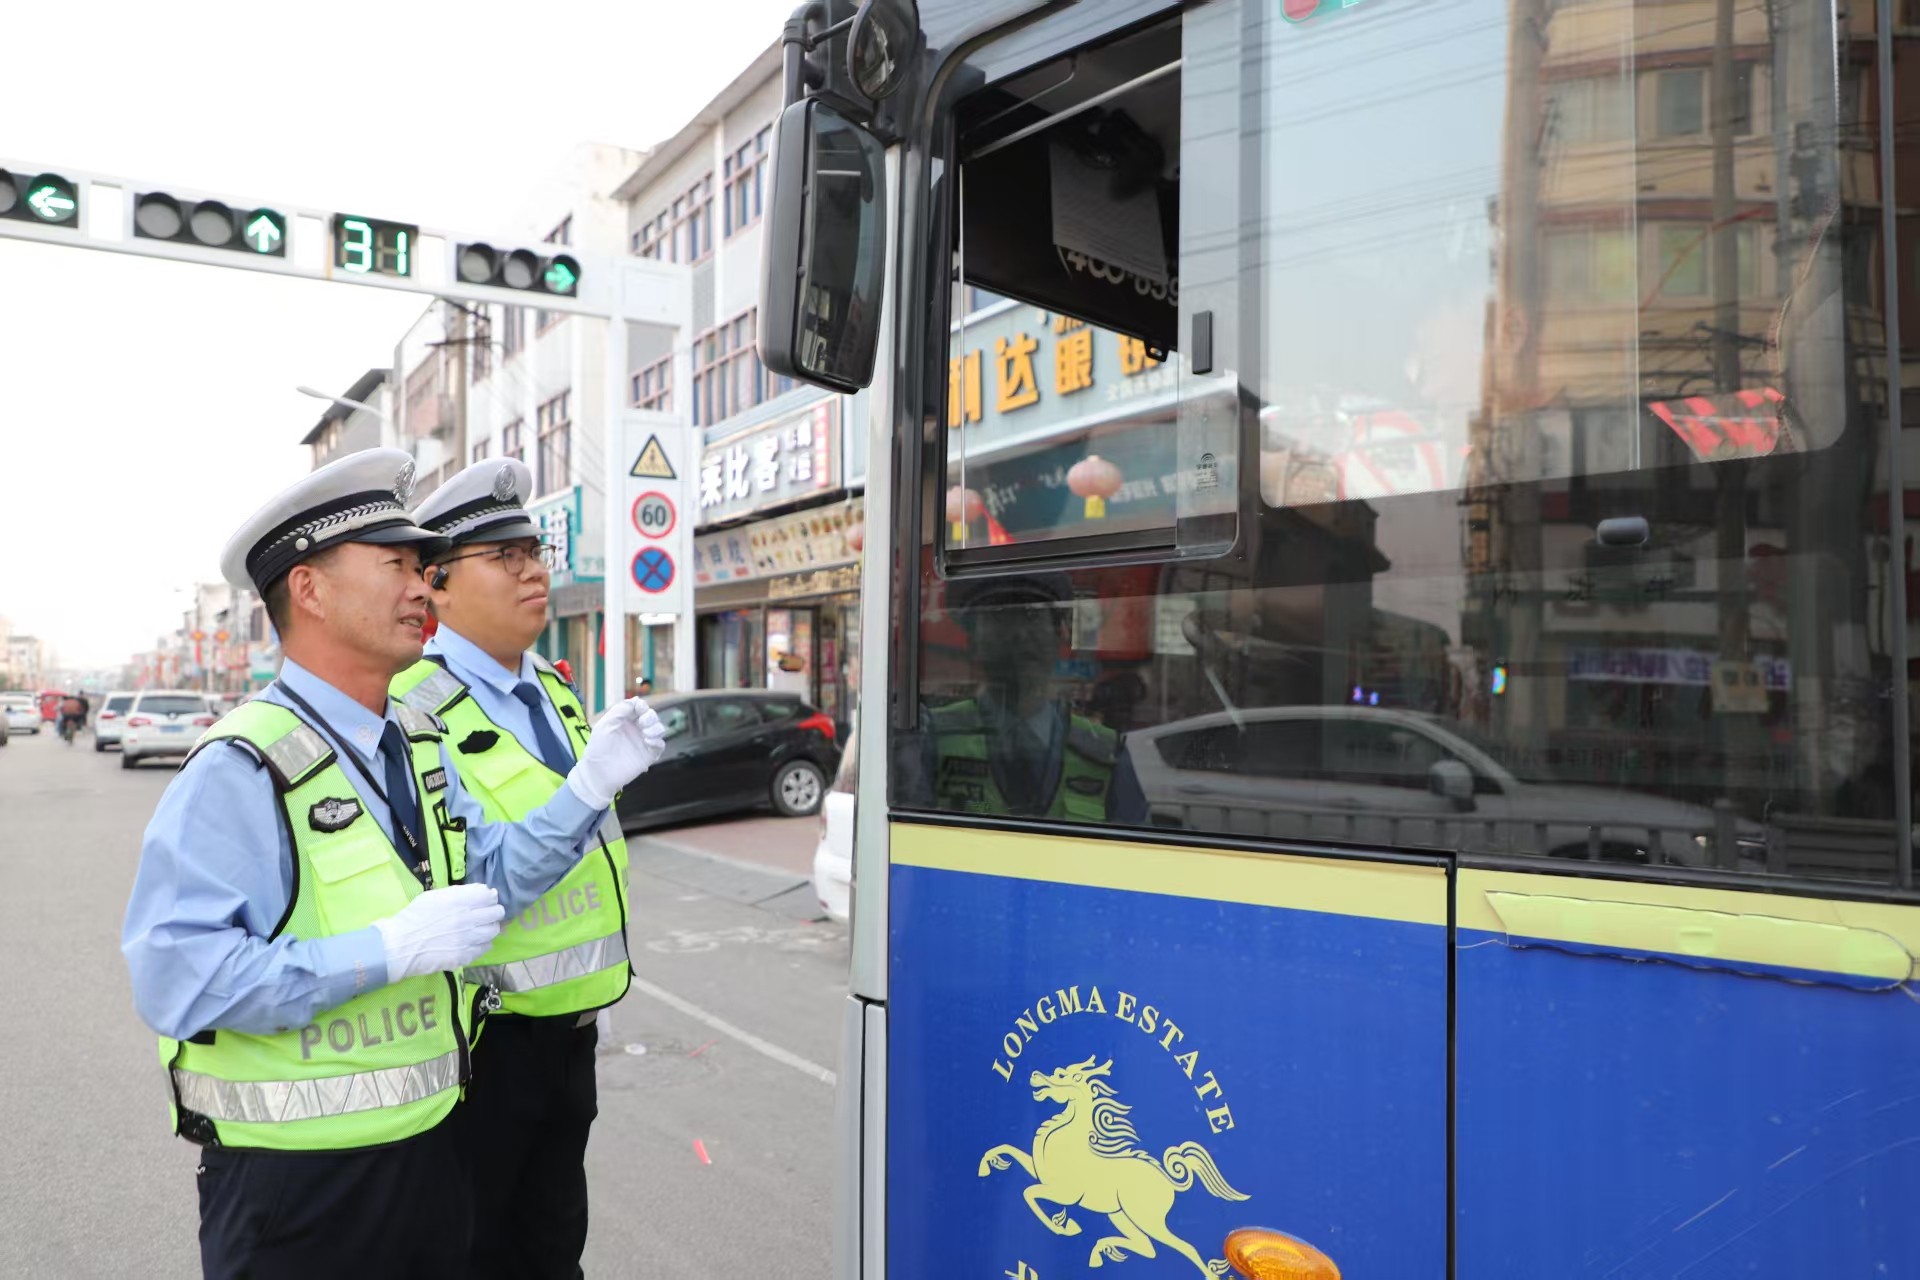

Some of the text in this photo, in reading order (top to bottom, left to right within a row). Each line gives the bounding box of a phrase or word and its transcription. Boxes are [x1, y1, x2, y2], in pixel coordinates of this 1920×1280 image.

[343, 219, 408, 275] 31
[642, 503, 666, 527] 60
[300, 994, 437, 1061] POLICE
[992, 985, 1236, 1135] LONGMA ESTATE
